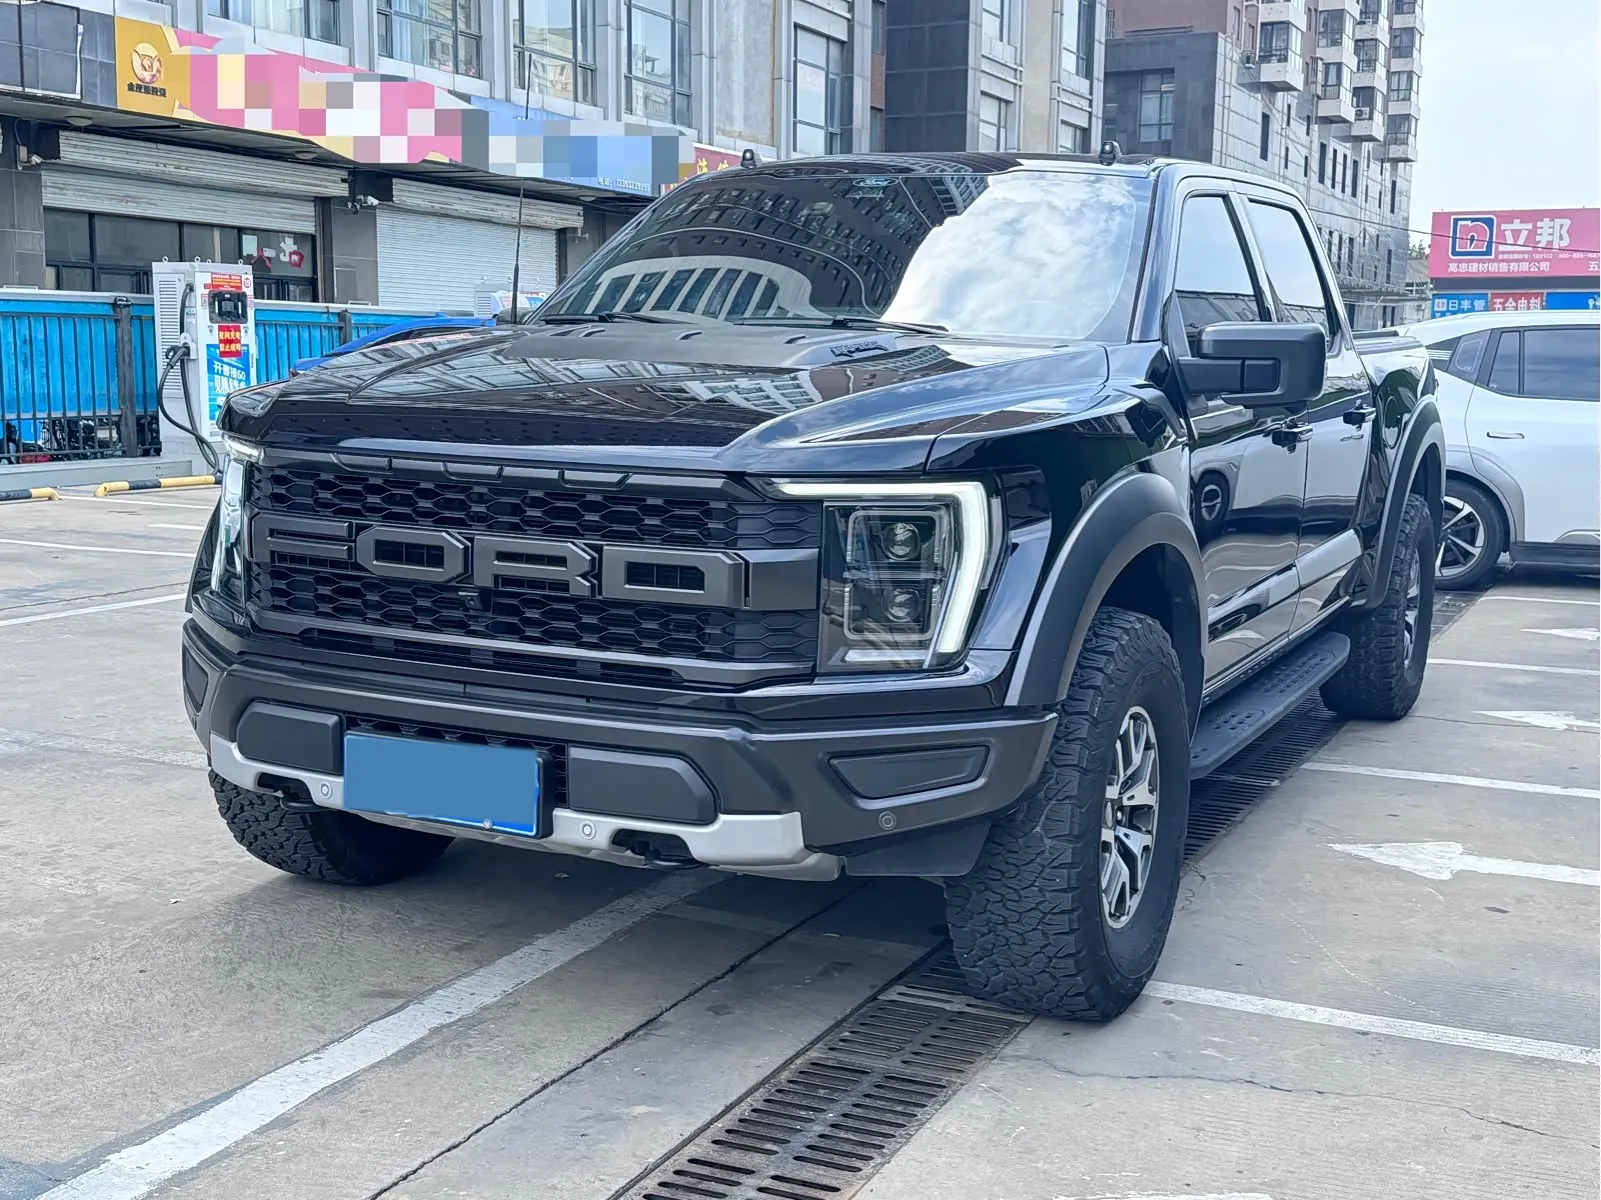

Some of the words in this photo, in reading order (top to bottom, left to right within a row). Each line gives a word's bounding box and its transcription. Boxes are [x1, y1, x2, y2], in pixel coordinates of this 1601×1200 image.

[1498, 217, 1572, 251] 立邦
[1448, 261, 1550, 273] 高忠建材销售有限公司
[1493, 297, 1541, 311] 五金电料
[250, 511, 747, 608] FORD
